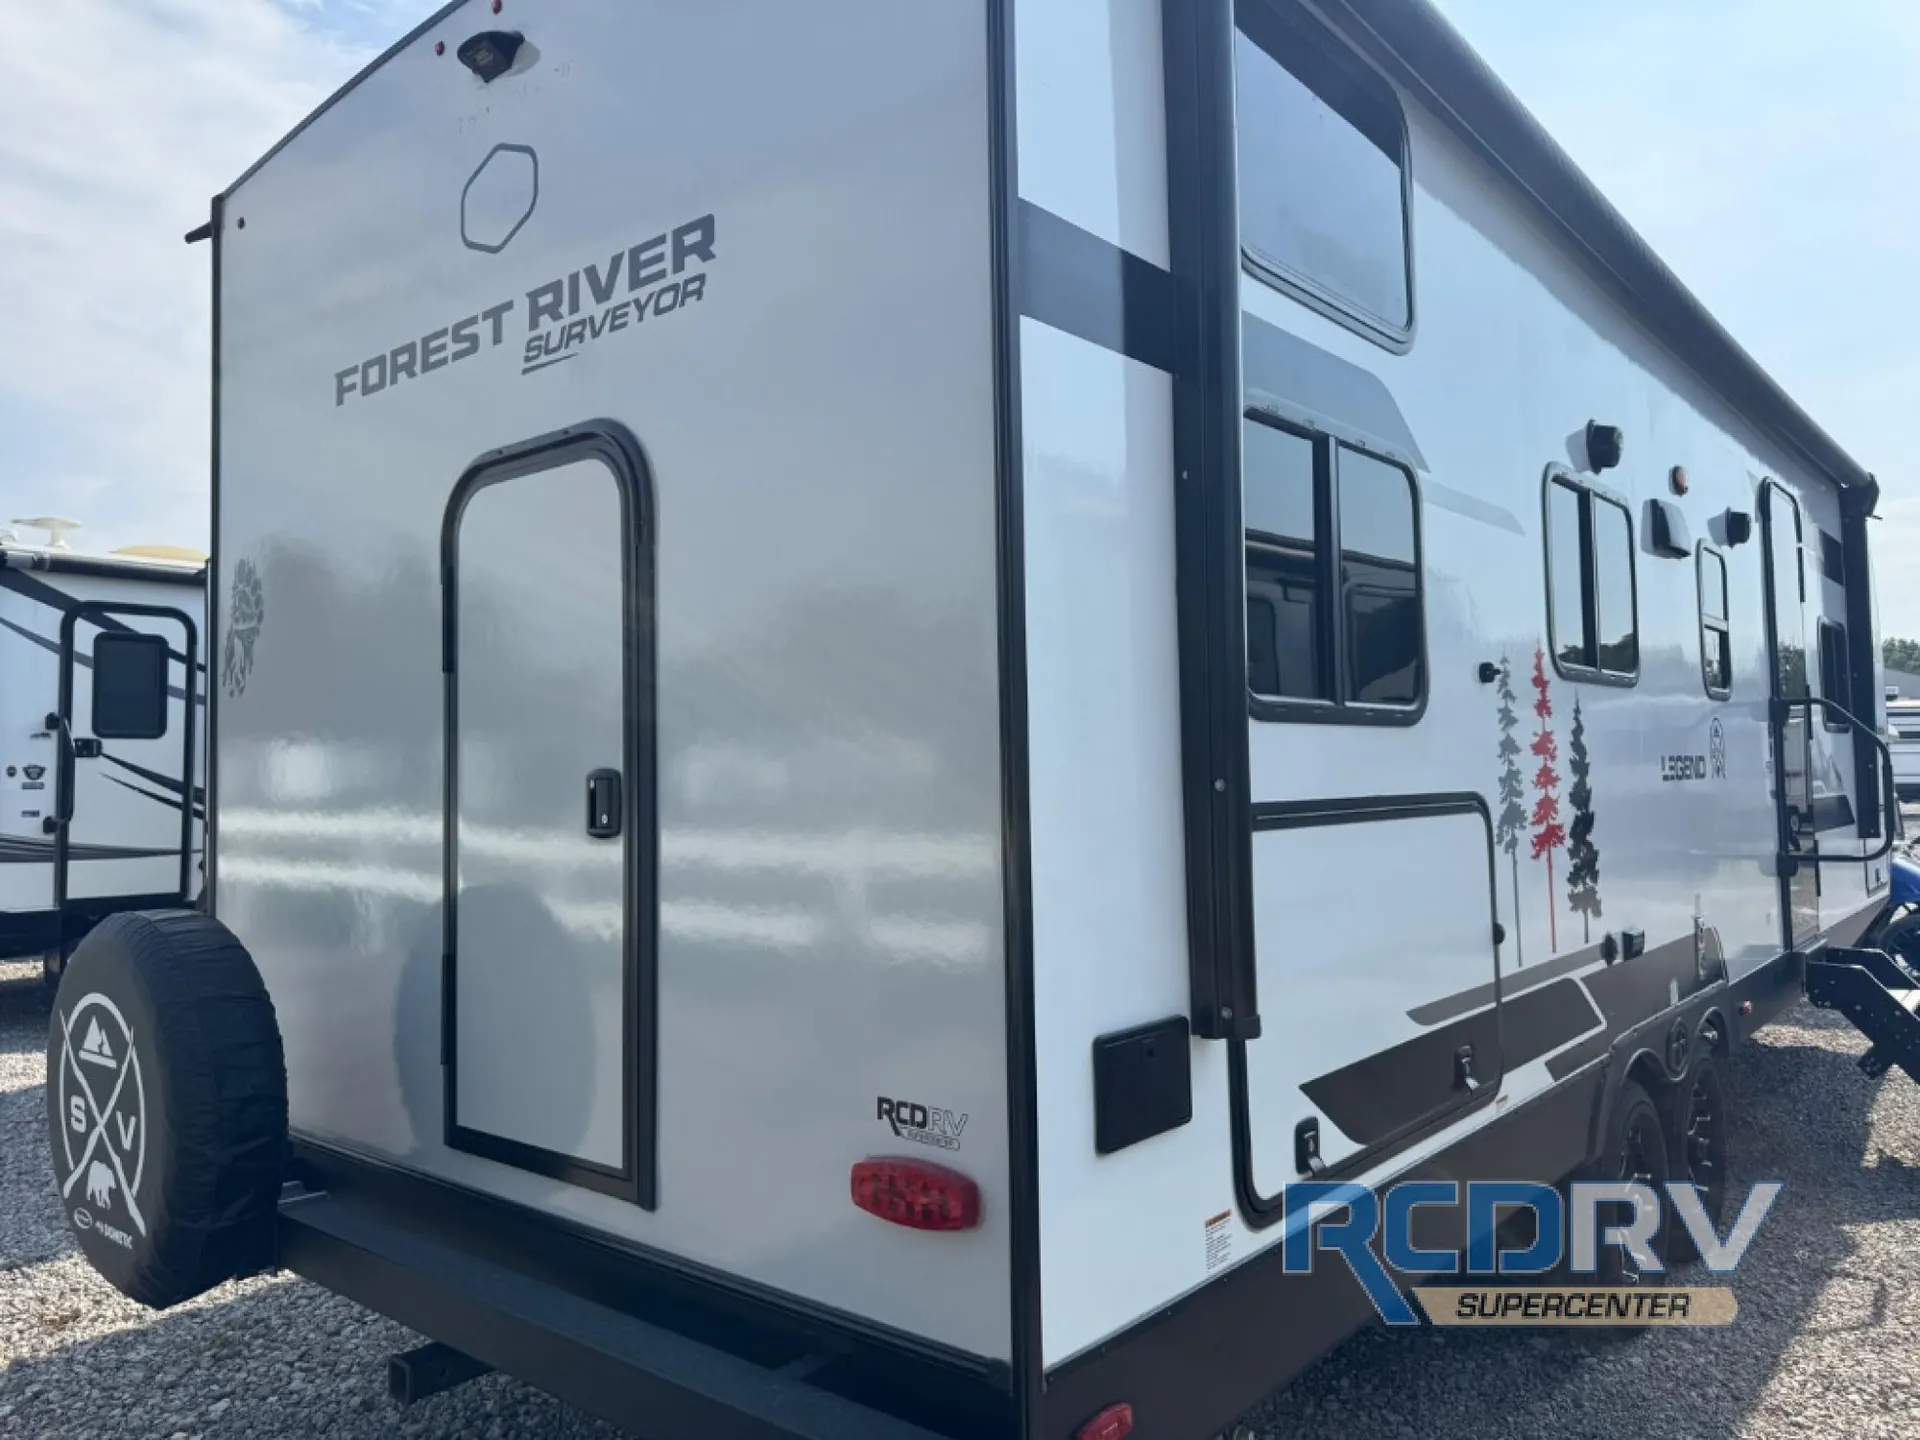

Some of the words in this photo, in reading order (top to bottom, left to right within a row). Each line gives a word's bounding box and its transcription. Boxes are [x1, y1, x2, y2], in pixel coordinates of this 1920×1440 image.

[334, 300, 515, 407] FOREST
[525, 213, 717, 332] RIVER
[523, 272, 707, 363] SURVEYOR
[1660, 755, 1706, 781] LEGEND
[70, 1094, 88, 1134] S
[115, 1110, 136, 1151] V
[876, 1095, 969, 1137] RCDRV
